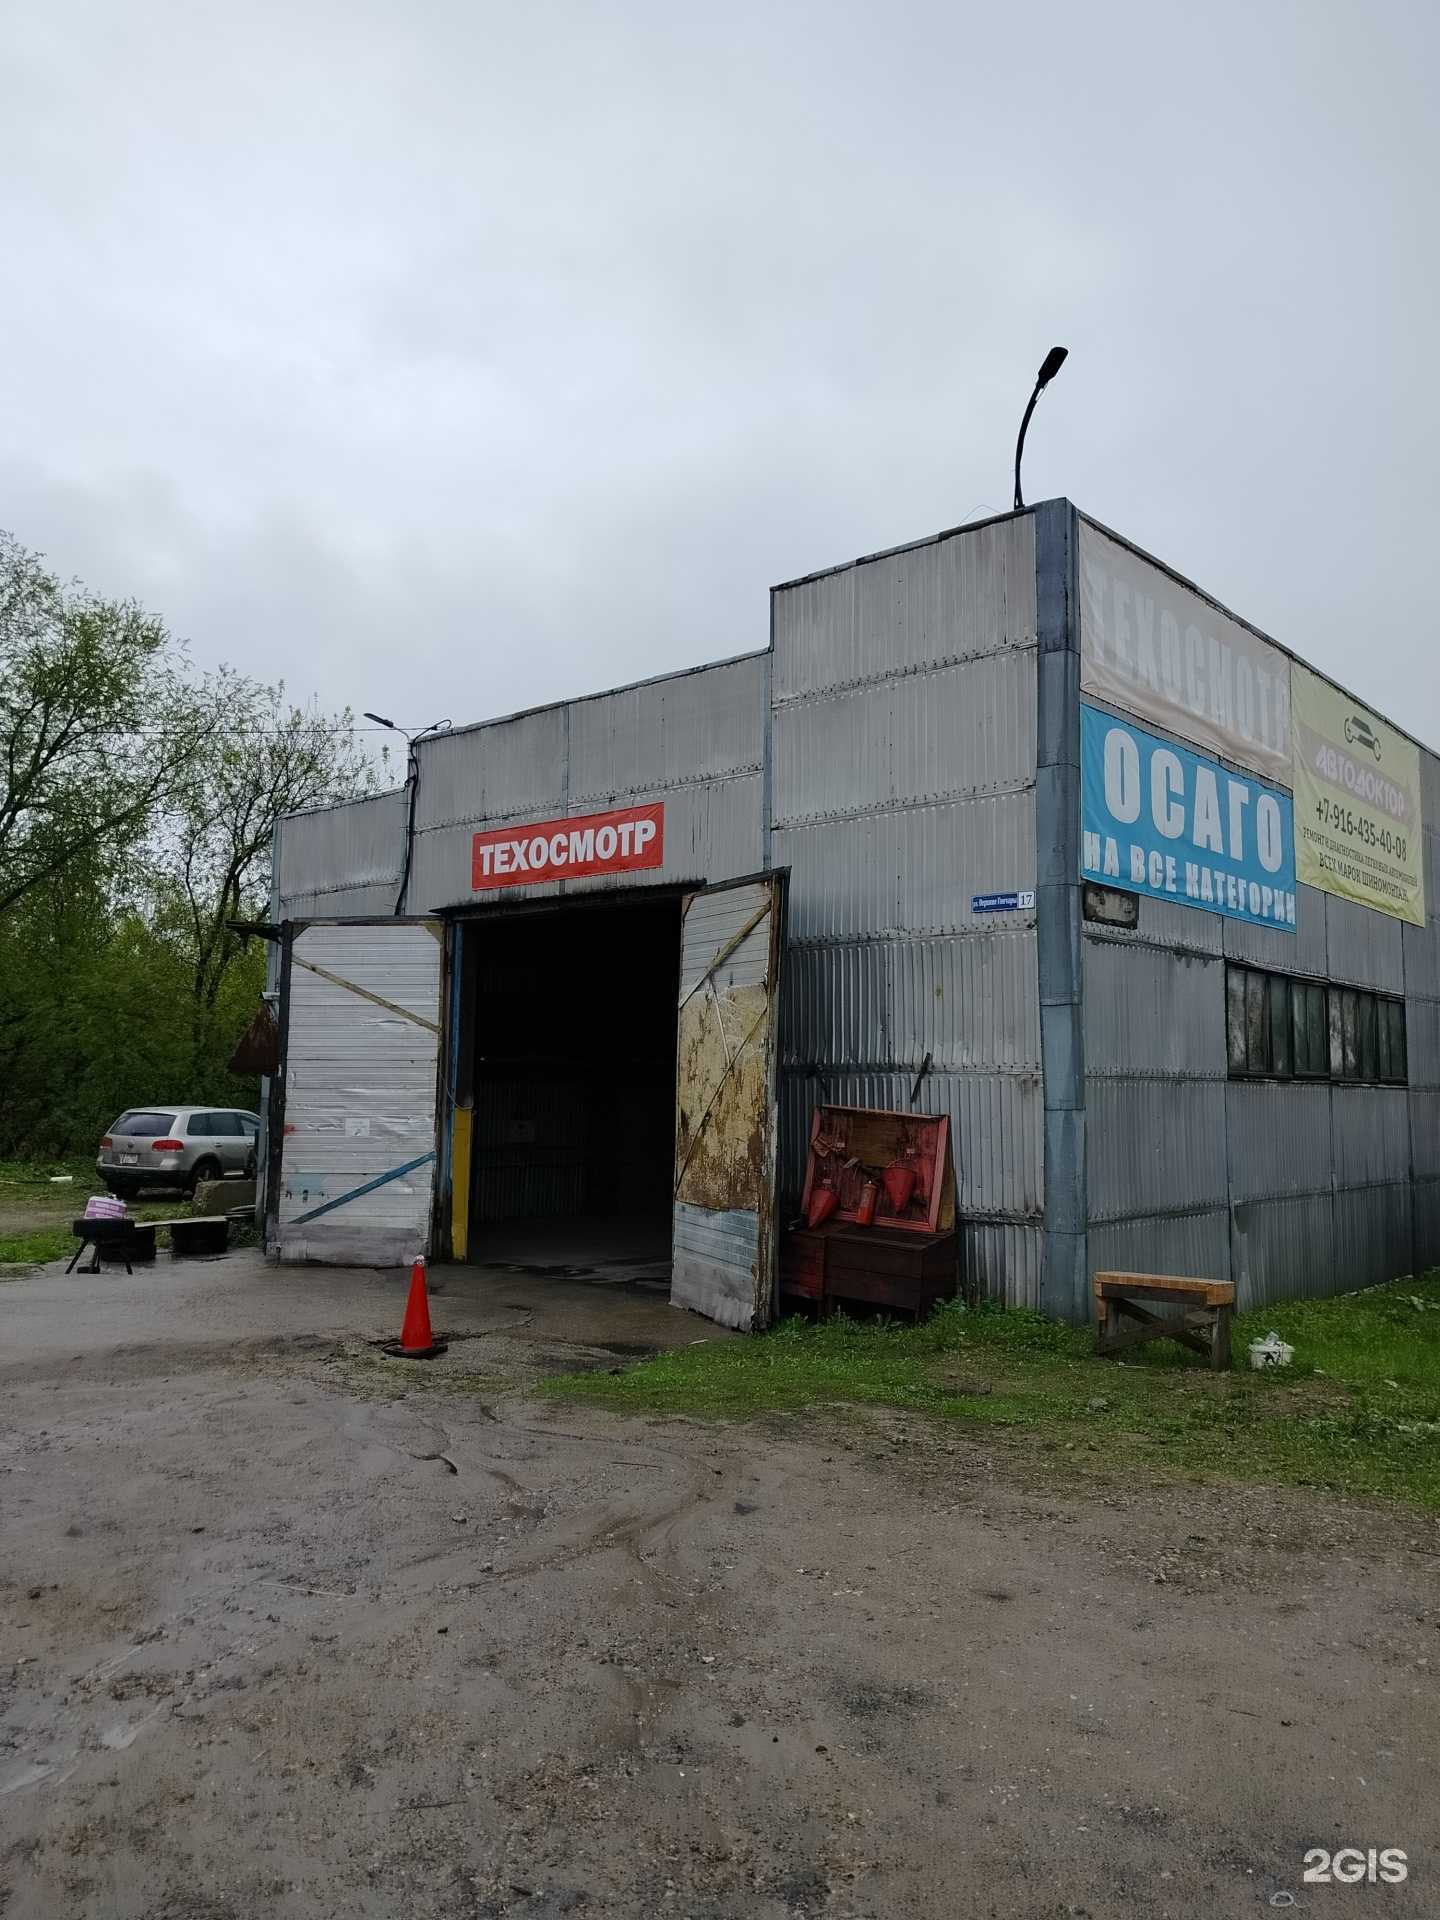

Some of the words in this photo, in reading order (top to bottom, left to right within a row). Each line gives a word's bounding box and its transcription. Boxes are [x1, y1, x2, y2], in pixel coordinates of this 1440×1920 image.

[1104, 728, 1283, 873] ОСАГО
[1316, 745, 1405, 817] АВТОДОКТОР
[480, 820, 656, 875] ТЕХОСМОТР
[1316, 798, 1407, 862] +7-916-435-40-08
[1021, 894, 1032, 905] 17
[1084, 832, 1119, 877] НА
[1131, 845, 1176, 893] ВСЕ
[1185, 862, 1296, 925] КАТЕГОРИИ
[1319, 852, 1335, 872] ВСЕХ
[1338, 860, 1361, 884] МАРОК
